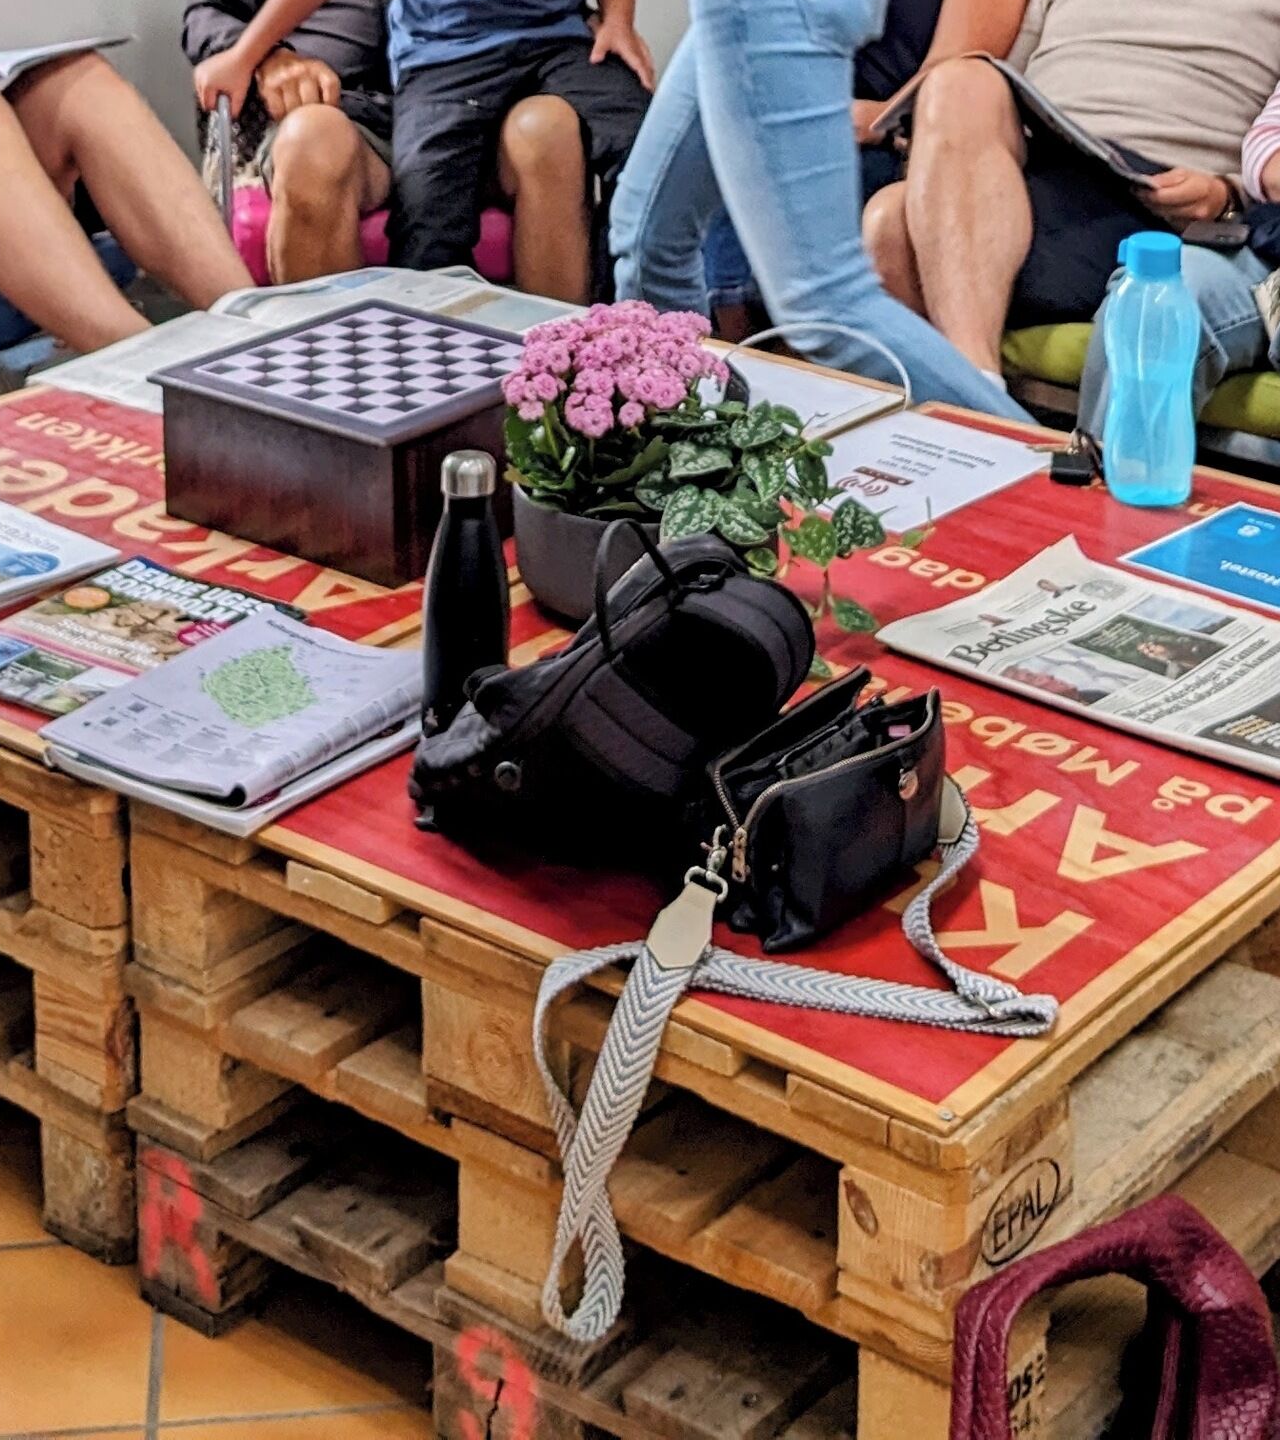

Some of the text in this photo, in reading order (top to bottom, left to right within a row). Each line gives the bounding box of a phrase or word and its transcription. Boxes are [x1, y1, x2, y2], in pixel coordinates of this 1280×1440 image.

[16, 412, 166, 477] rikken
[95, 568, 241, 624] BORNHOLM
[117, 558, 204, 597] DENNE
[868, 546, 990, 591] dag
[947, 599, 1098, 667] Berlingske
[1152, 776, 1273, 825] på
[990, 1176, 1050, 1253] EPAL
